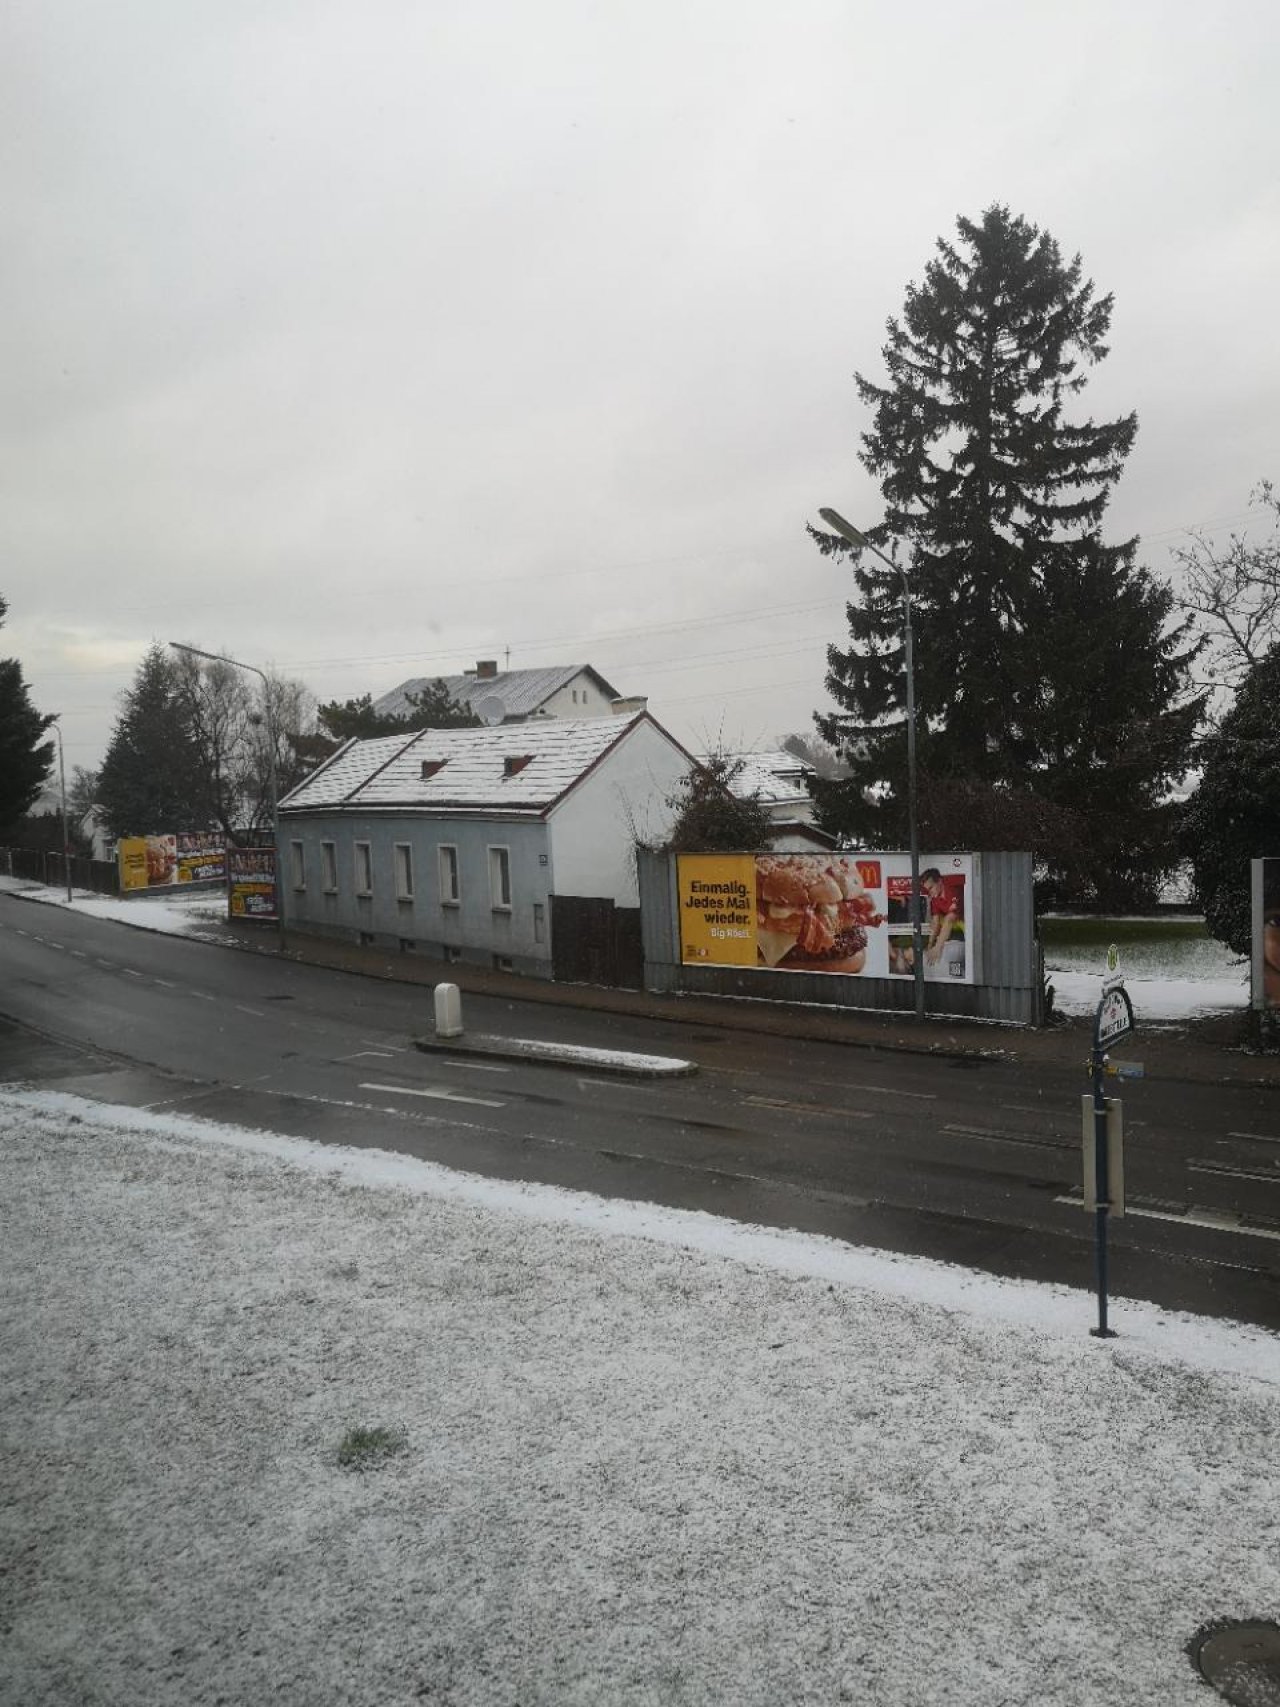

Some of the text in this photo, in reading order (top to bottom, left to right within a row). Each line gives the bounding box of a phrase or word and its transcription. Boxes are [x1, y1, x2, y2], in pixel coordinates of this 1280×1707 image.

[691, 880, 751, 897] Einmalig.
[685, 896, 750, 909] Jedes Mal
[704, 910, 751, 924] wieder.
[711, 927, 725, 939] Big
